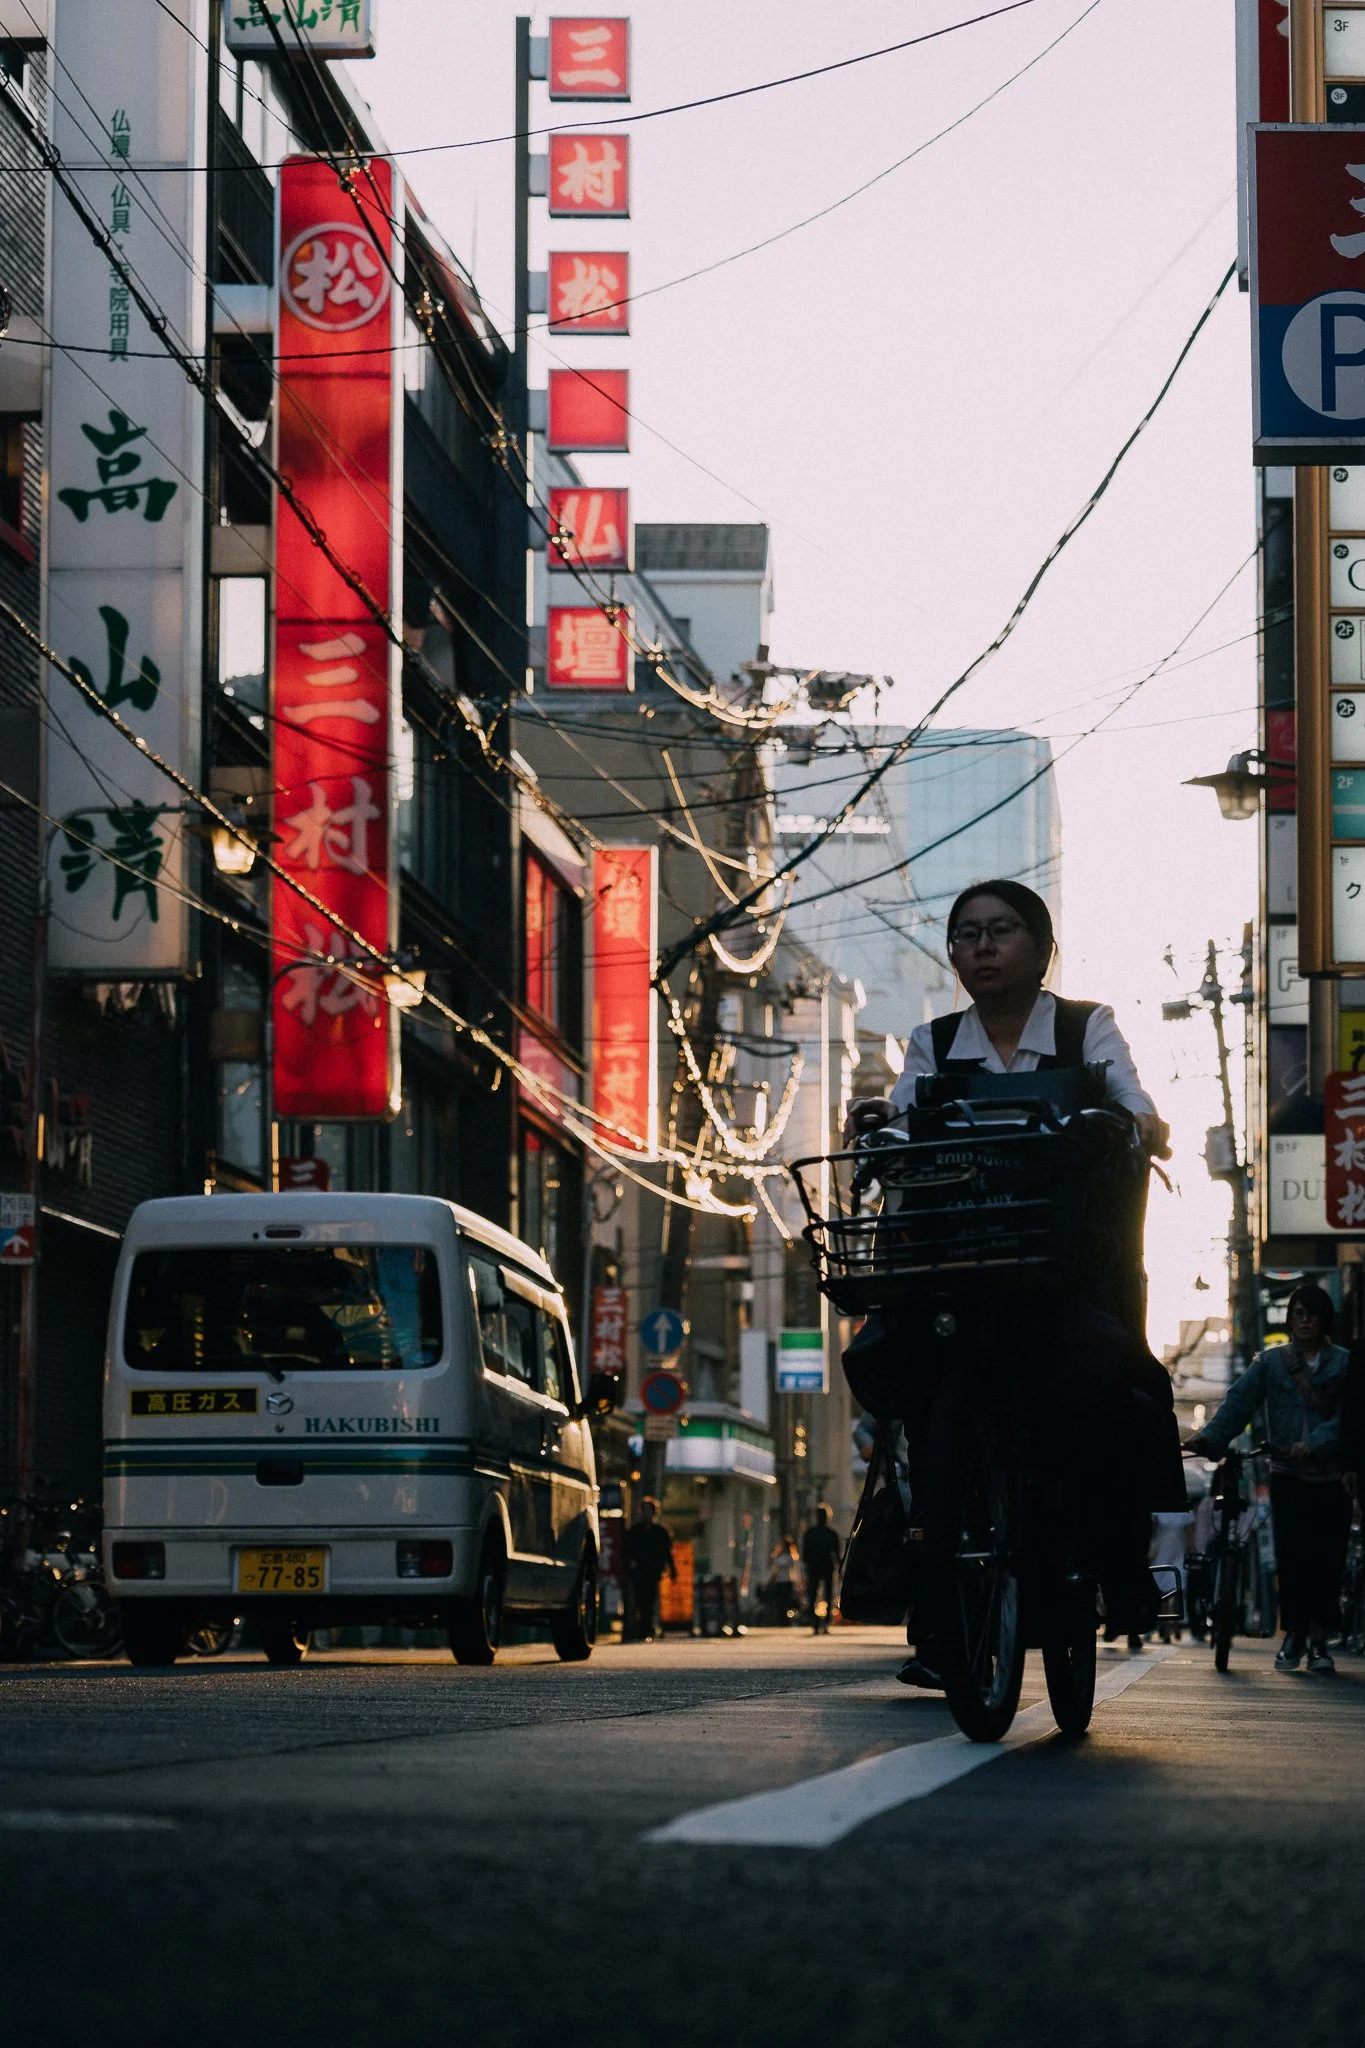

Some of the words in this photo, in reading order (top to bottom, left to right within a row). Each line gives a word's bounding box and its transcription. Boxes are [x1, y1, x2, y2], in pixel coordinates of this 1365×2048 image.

[1333, 19, 1349, 32] 3F
[1333, 91, 1345, 101] 3F
[558, 26, 622, 324] 三村松
[293, 241, 379, 313] 松
[1320, 303, 1365, 412] P
[1335, 471, 1347, 480] 2F
[1335, 547, 1347, 556] 2F
[555, 495, 621, 678] 仏壇
[1337, 624, 1353, 635] 2F
[1338, 703, 1354, 714] 2F
[1338, 776, 1354, 789] 2F
[283, 632, 381, 1026] 三村松
[1346, 882, 1361, 899] ク
[147, 1391, 242, 1412] 高圧ガス
[304, 1417, 441, 1434] HAKUBISHI
[258, 1567, 320, 1588] 77-85
